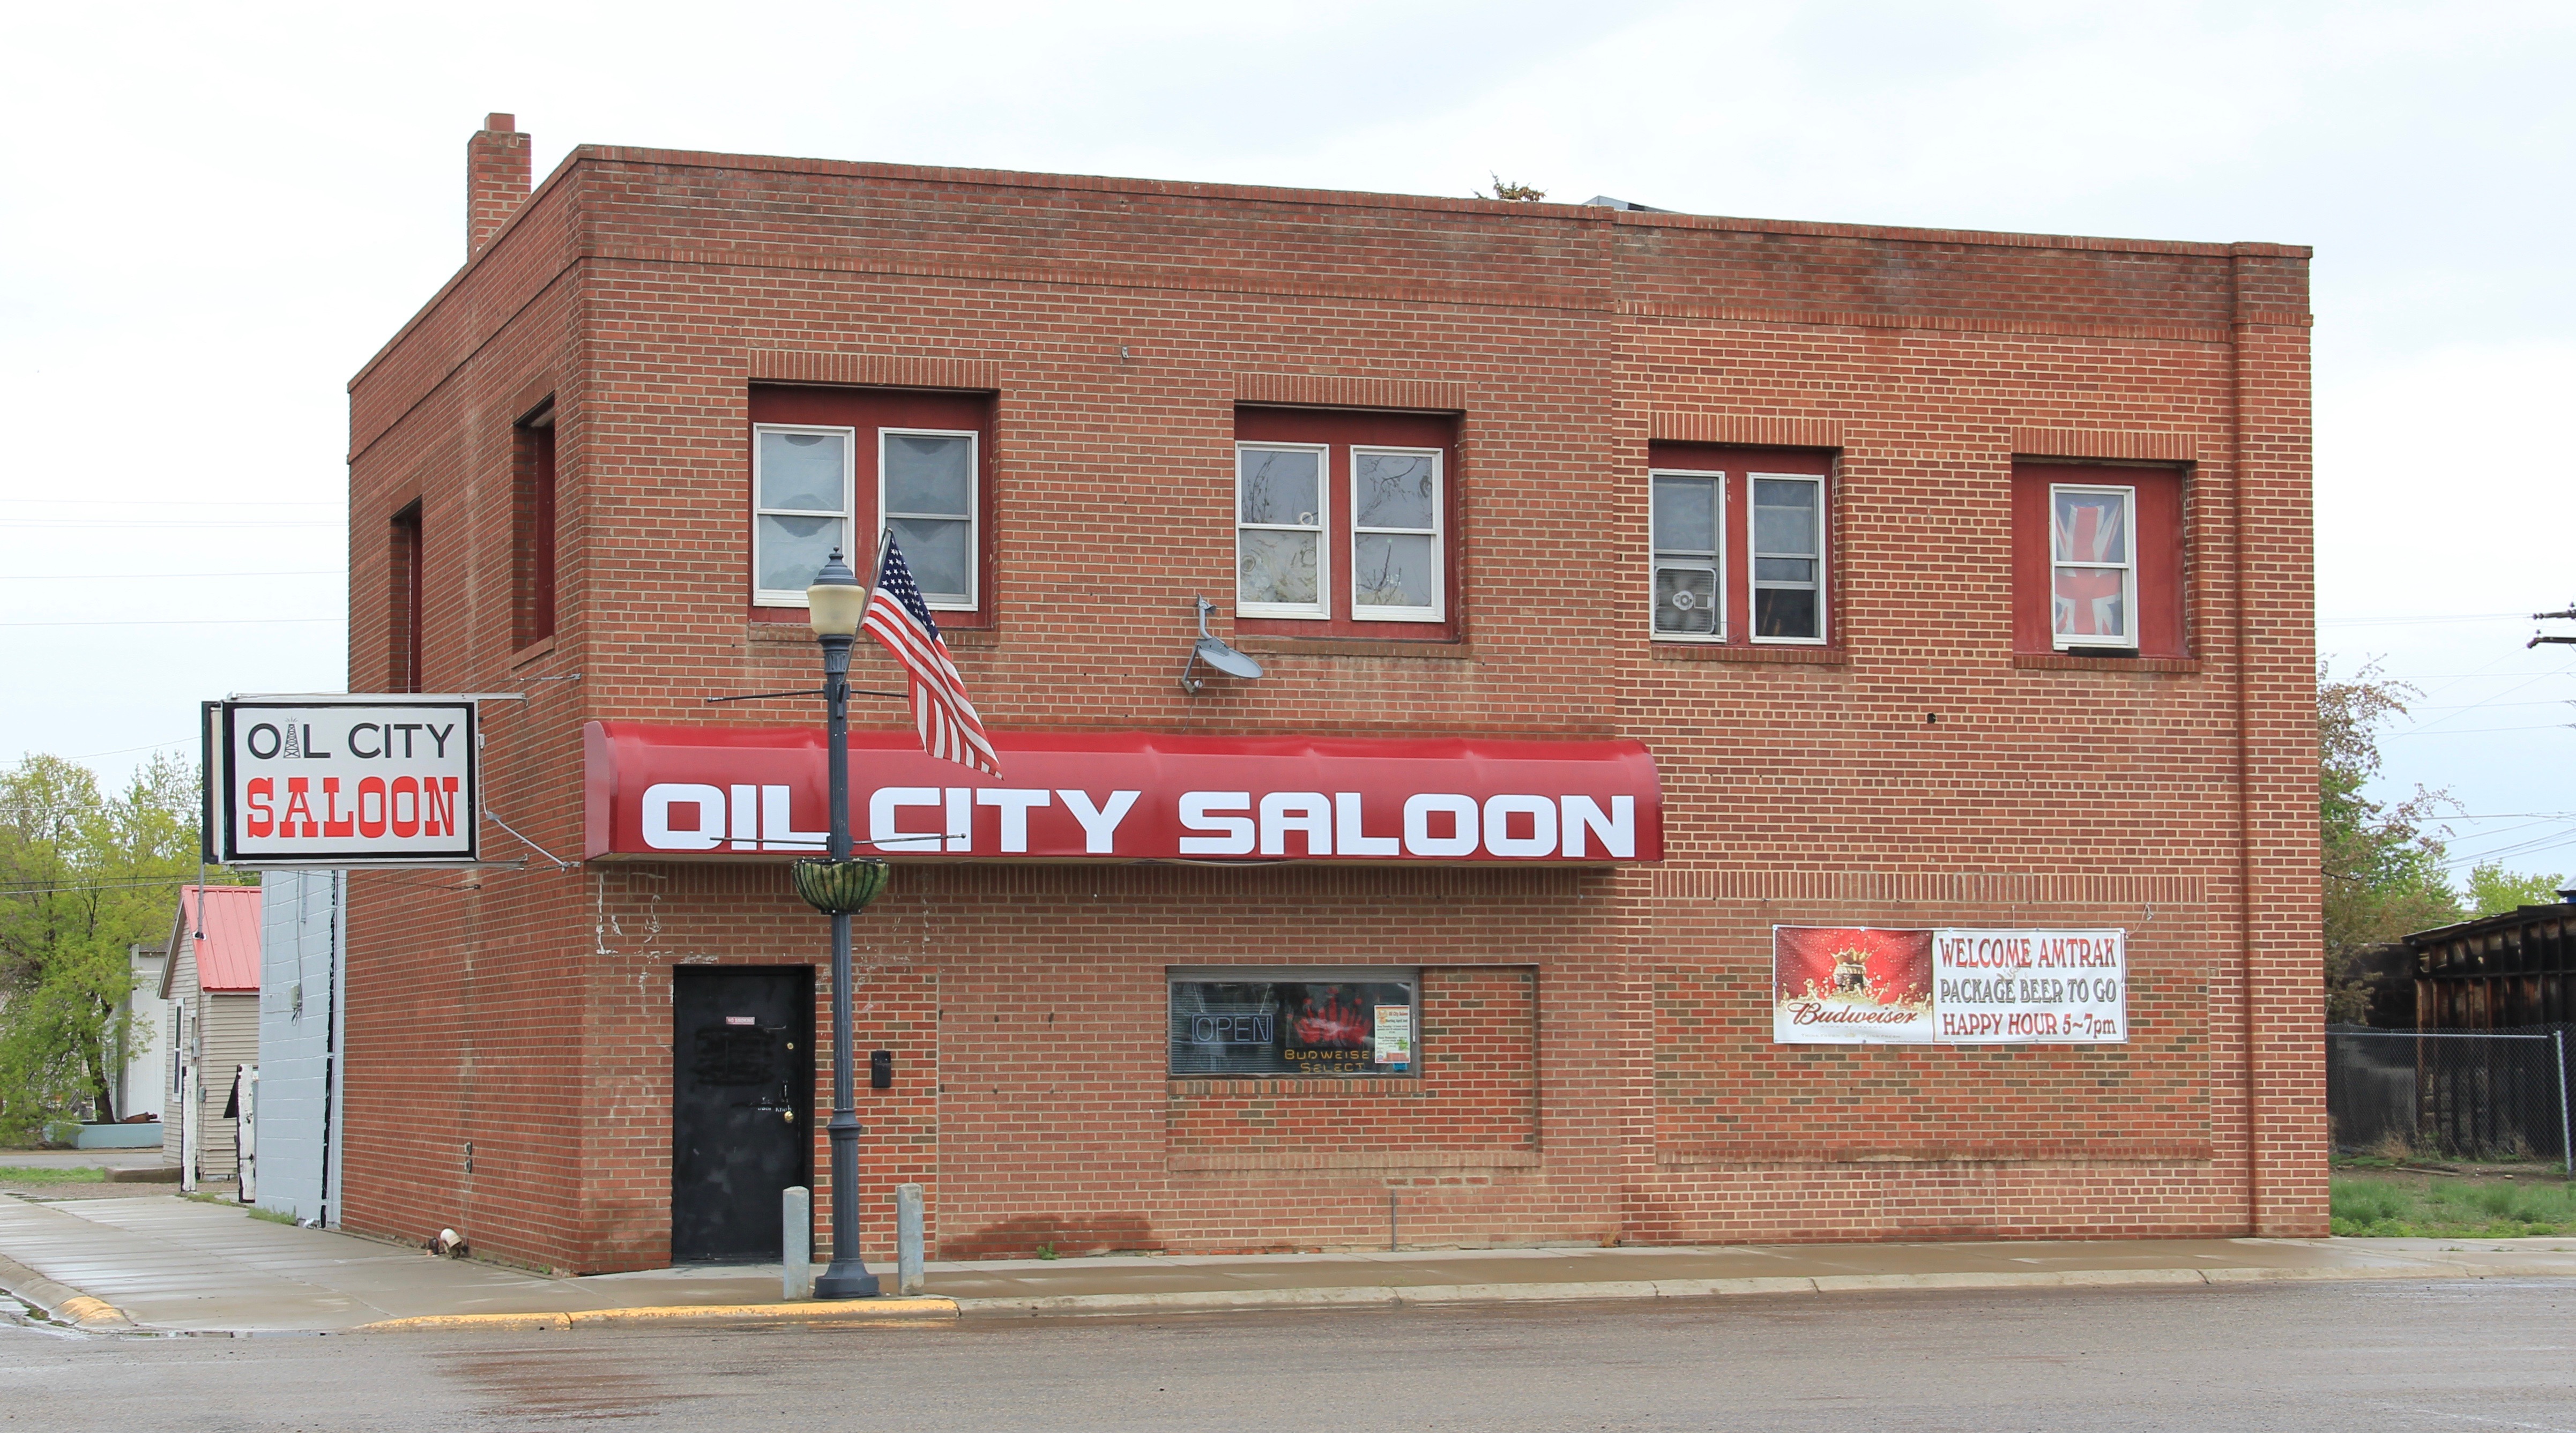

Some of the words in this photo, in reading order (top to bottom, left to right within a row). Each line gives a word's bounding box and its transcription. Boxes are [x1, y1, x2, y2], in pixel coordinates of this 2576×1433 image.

[247, 717, 331, 759] OIL
[348, 722, 455, 758] CITY
[247, 775, 459, 838] SALOON
[642, 783, 831, 851] OIL
[869, 787, 1142, 854] CITY
[1178, 790, 1636, 857] SALOON
[1939, 938, 2032, 968] WELCOME
[2038, 938, 2116, 968] AMTRAK
[1939, 978, 2016, 1003] PACKAGE
[2019, 978, 2064, 1003] BEER
[2067, 978, 2088, 1003] TO
[2093, 978, 2116, 1003] GO
[1786, 1002, 1918, 1025] Budweiser
[1941, 1013, 2003, 1035] HAPPY
[2007, 1013, 2058, 1035] HOUR
[1196, 1017, 1269, 1041] OPEN
